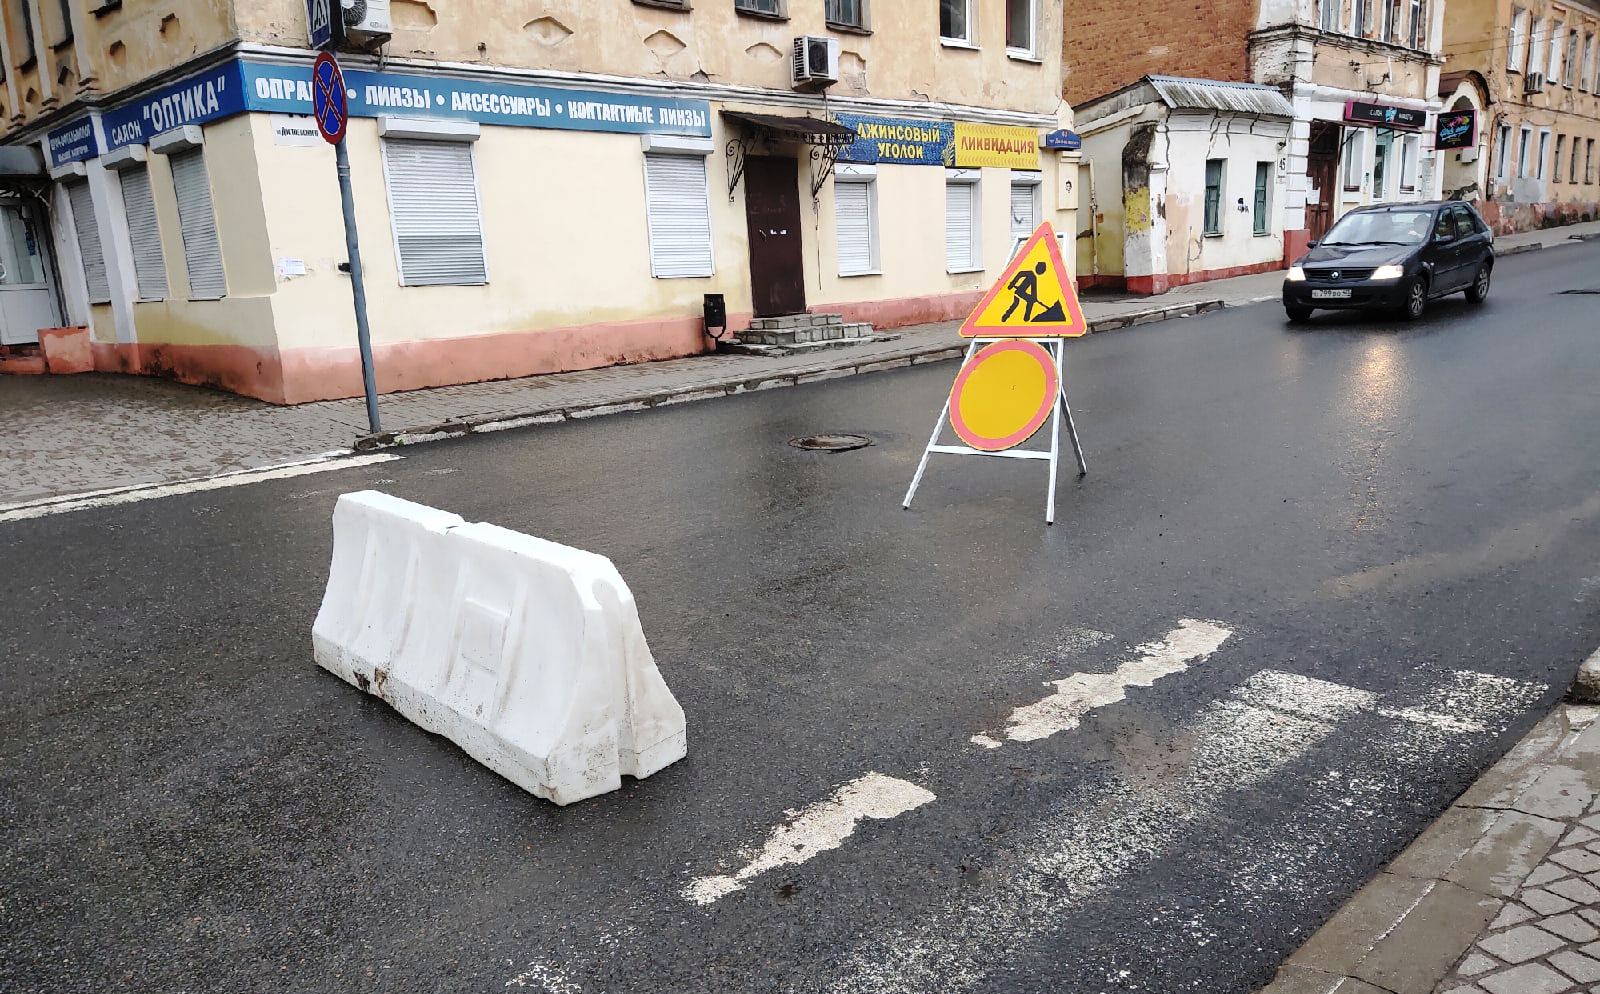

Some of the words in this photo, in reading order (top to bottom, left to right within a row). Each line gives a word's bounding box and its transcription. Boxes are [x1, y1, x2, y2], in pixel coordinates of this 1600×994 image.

[112, 119, 142, 145] САЛОН
[143, 75, 225, 132] "ОПТИКА"
[365, 85, 431, 109] ЛИНЗЫ
[451, 91, 550, 117] АКСЕССУАРЫ
[567, 99, 655, 124] КОНТАКТНЫЕ
[659, 108, 706, 128] ЛИНЗЫ
[857, 122, 942, 144] ДЖИНСОВЫЙ
[877, 142, 924, 160] УГОЛОК
[961, 136, 1035, 154] ЛИКВИДАЦИЯ
